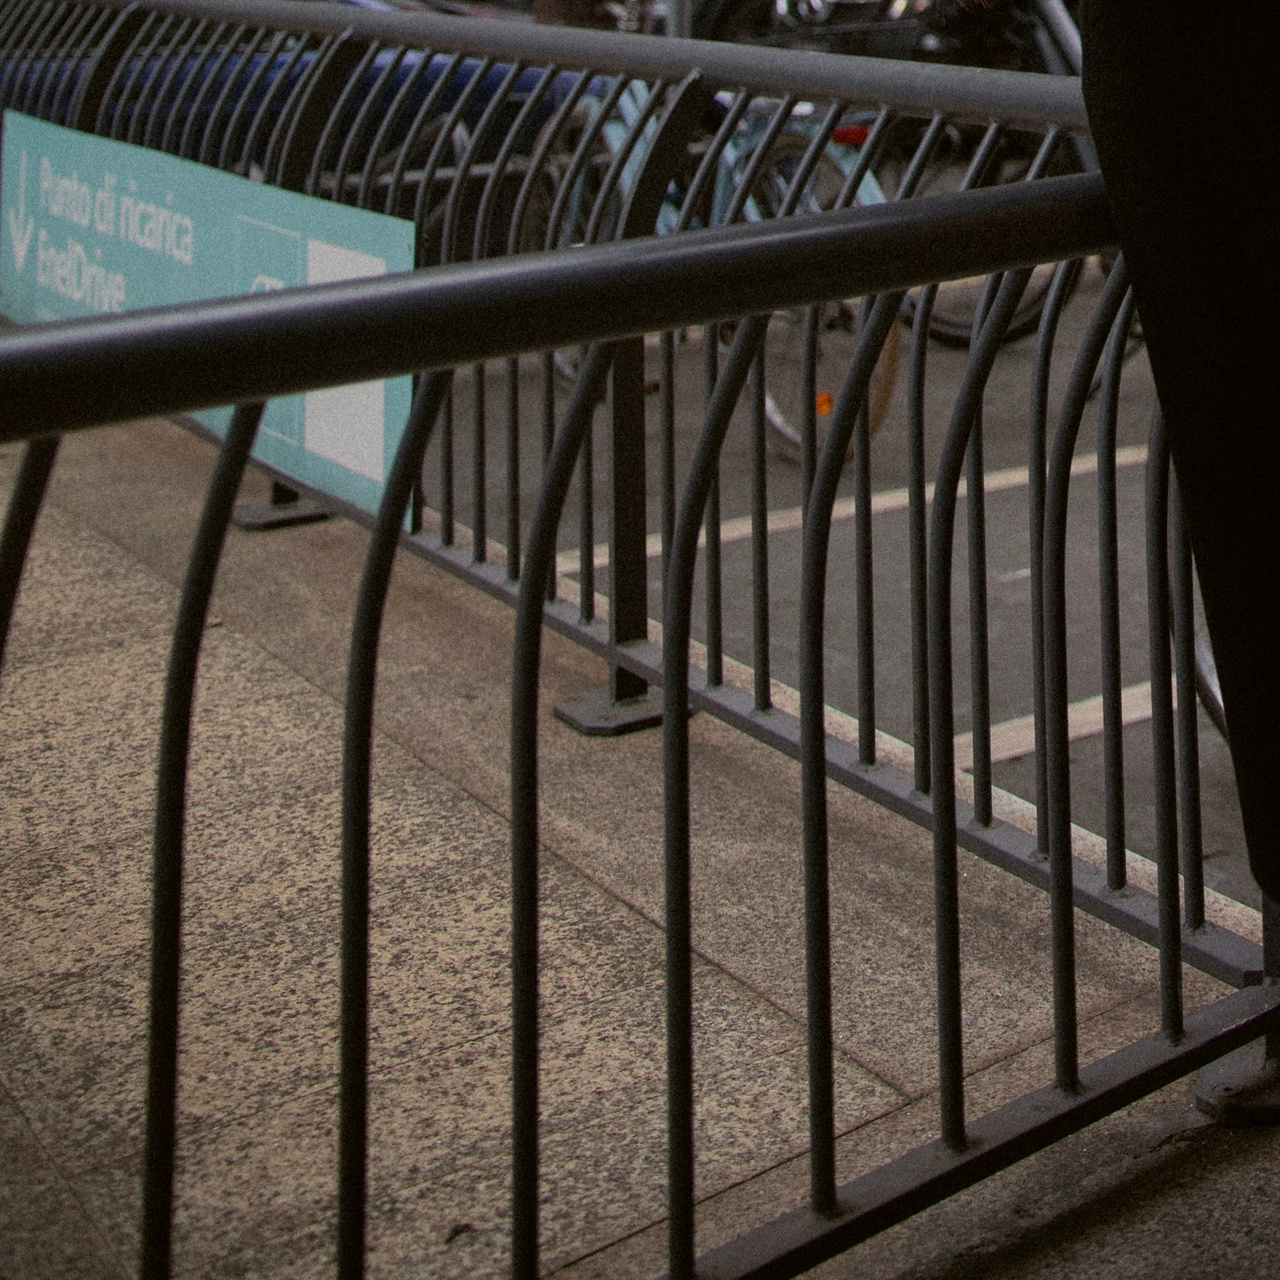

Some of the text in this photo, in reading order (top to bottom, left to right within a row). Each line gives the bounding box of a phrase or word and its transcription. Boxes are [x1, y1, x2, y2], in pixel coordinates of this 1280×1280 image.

[39, 155, 194, 266] Punto di ricarica
